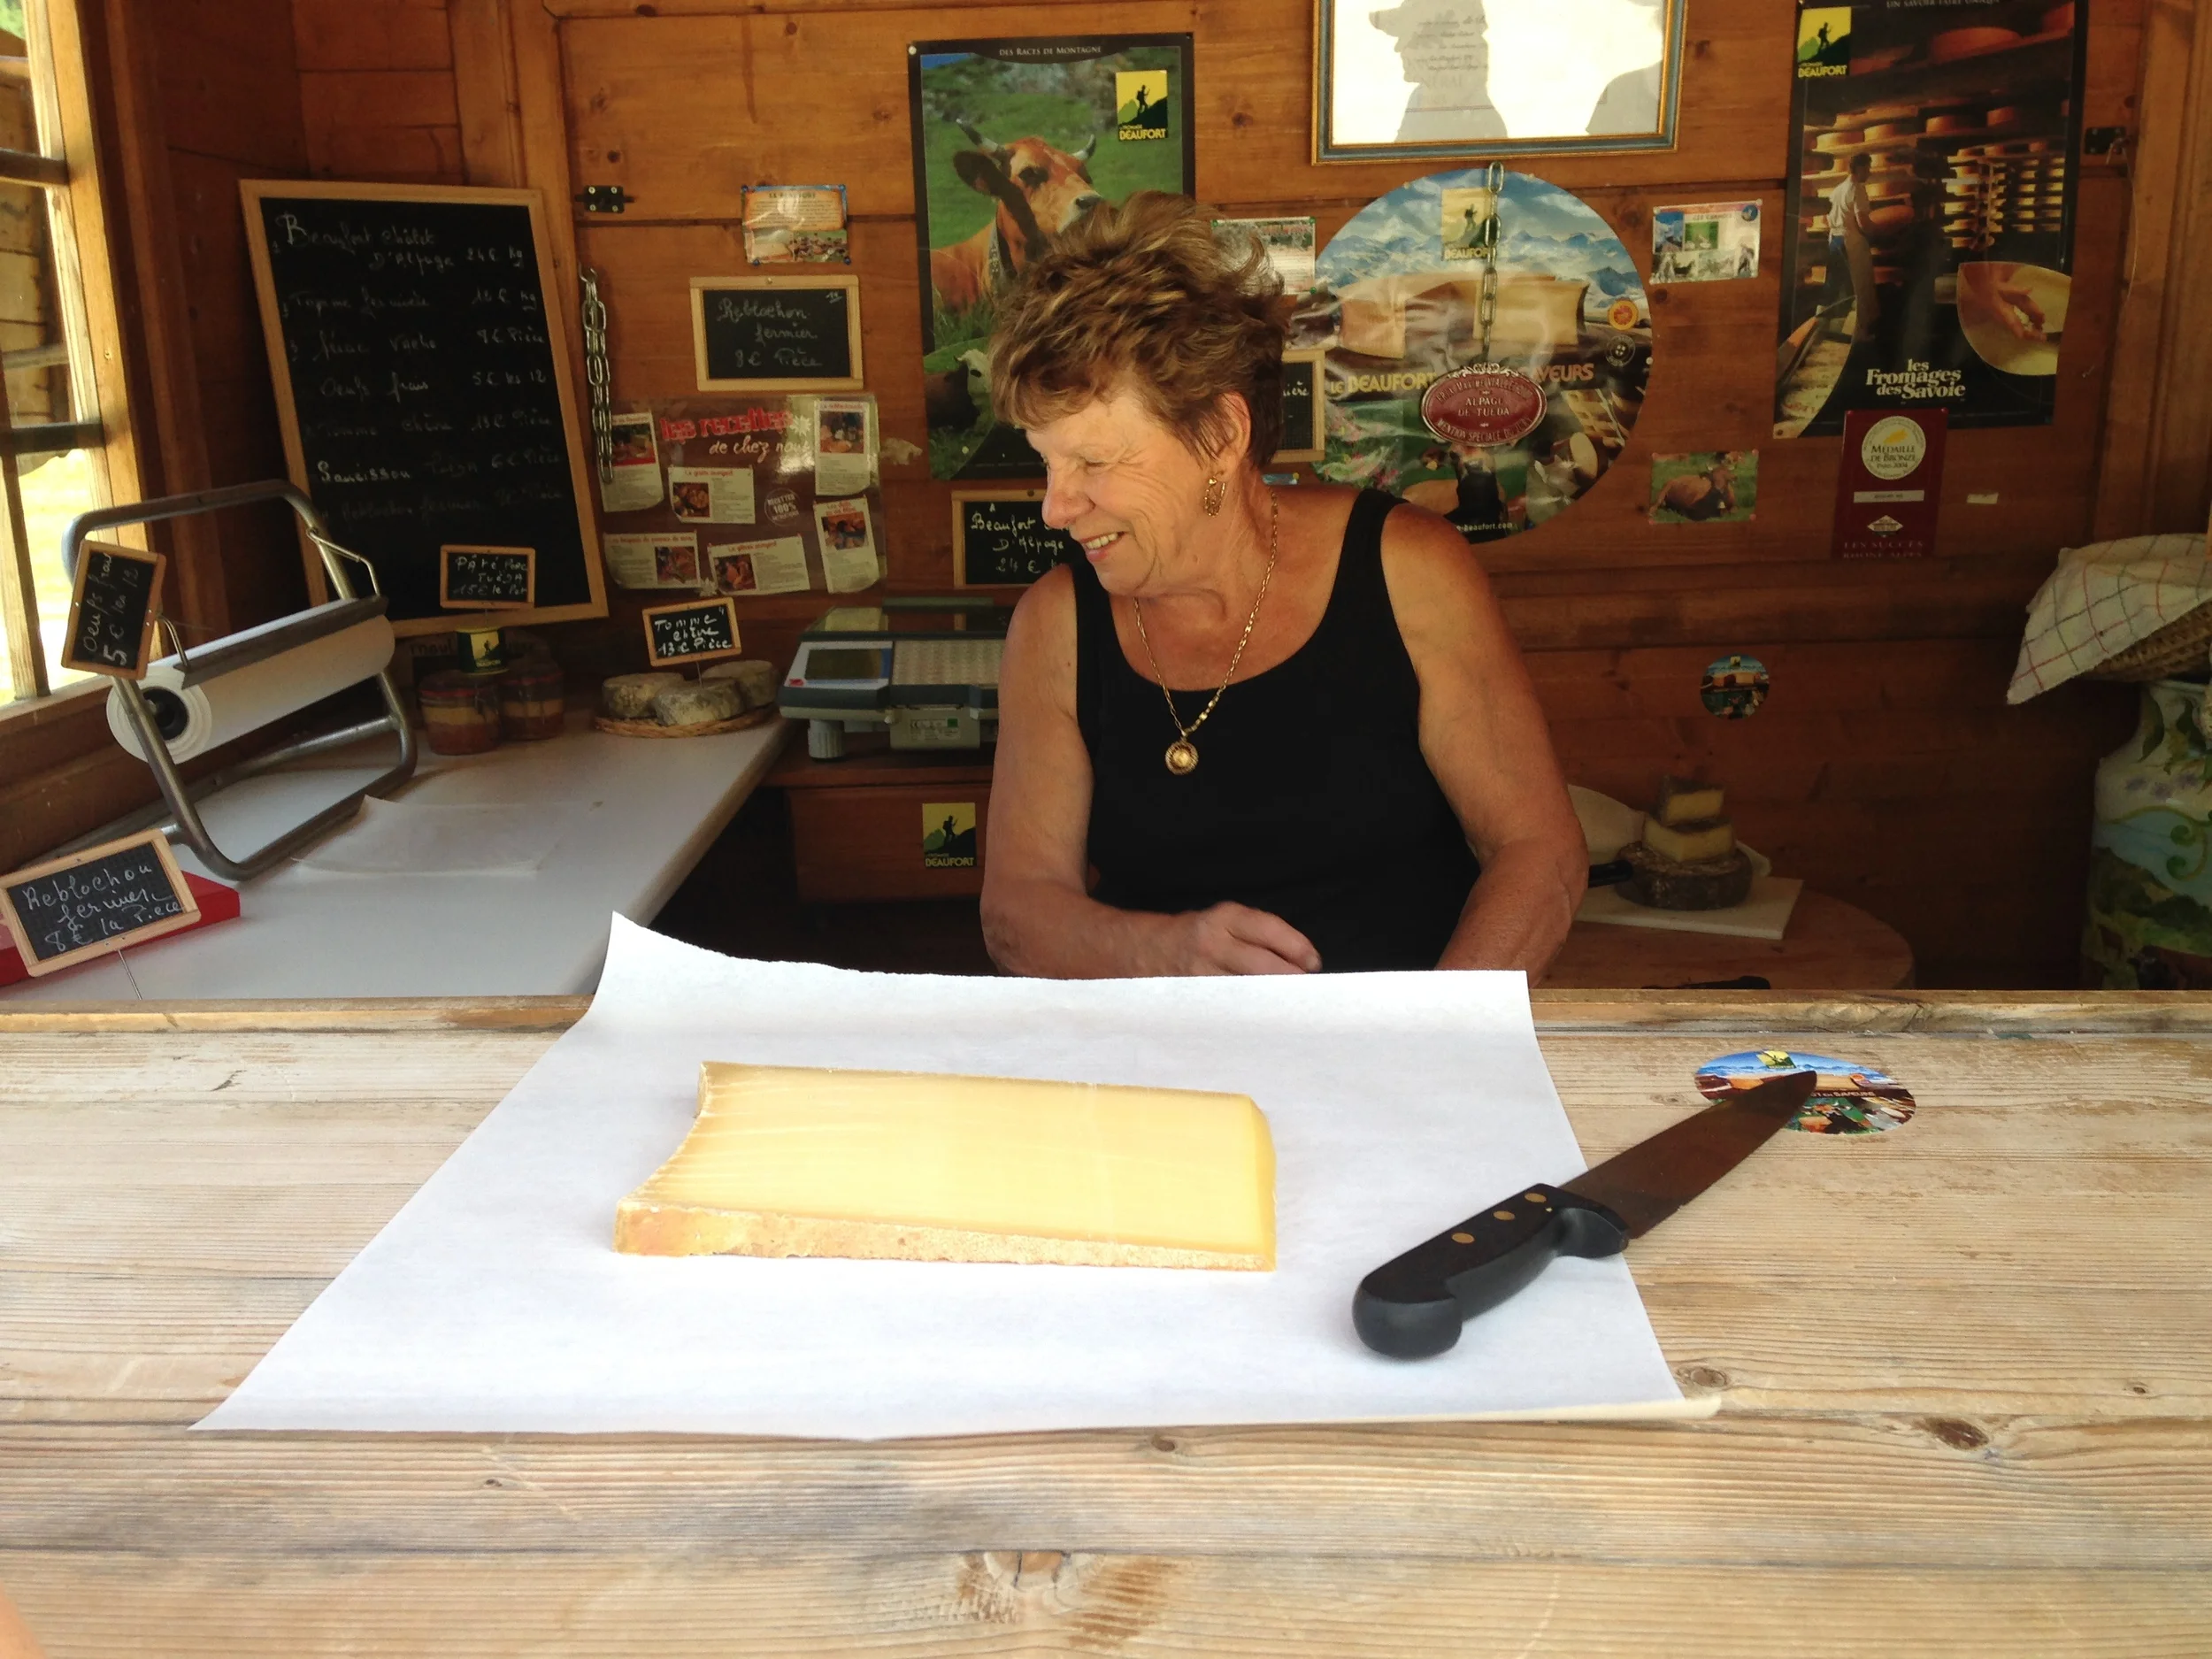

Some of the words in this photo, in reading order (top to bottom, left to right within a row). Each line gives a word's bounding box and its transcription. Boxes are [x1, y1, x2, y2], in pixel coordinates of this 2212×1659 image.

[1017, 47, 1041, 56] RACES
[1056, 45, 1102, 54] MONTAGNE
[1798, 65, 1847, 78] BEAUFORT
[1119, 127, 1166, 140] BEAUFORT
[1444, 248, 1489, 260] BEAUFOR
[1907, 358, 1930, 372] les
[1348, 373, 1437, 393] BEAUFORT
[1865, 368, 1962, 387] Fromages
[1876, 383, 1901, 396] des
[1901, 380, 1966, 399] Savoie
[1465, 397, 1503, 406] ALPAGE
[1476, 407, 1509, 417] TUEDA
[659, 417, 697, 444] les
[698, 407, 793, 437] recettes
[709, 440, 727, 455] de
[733, 435, 769, 464] chez
[773, 502, 797, 513] 100%
[970, 511, 1036, 538] Beaufort
[1455, 522, 1513, 532] e-beaufort.com
[926, 856, 975, 867] BEAUFORT
[22, 863, 153, 910] Reblochon
[100, 918, 125, 936] la
